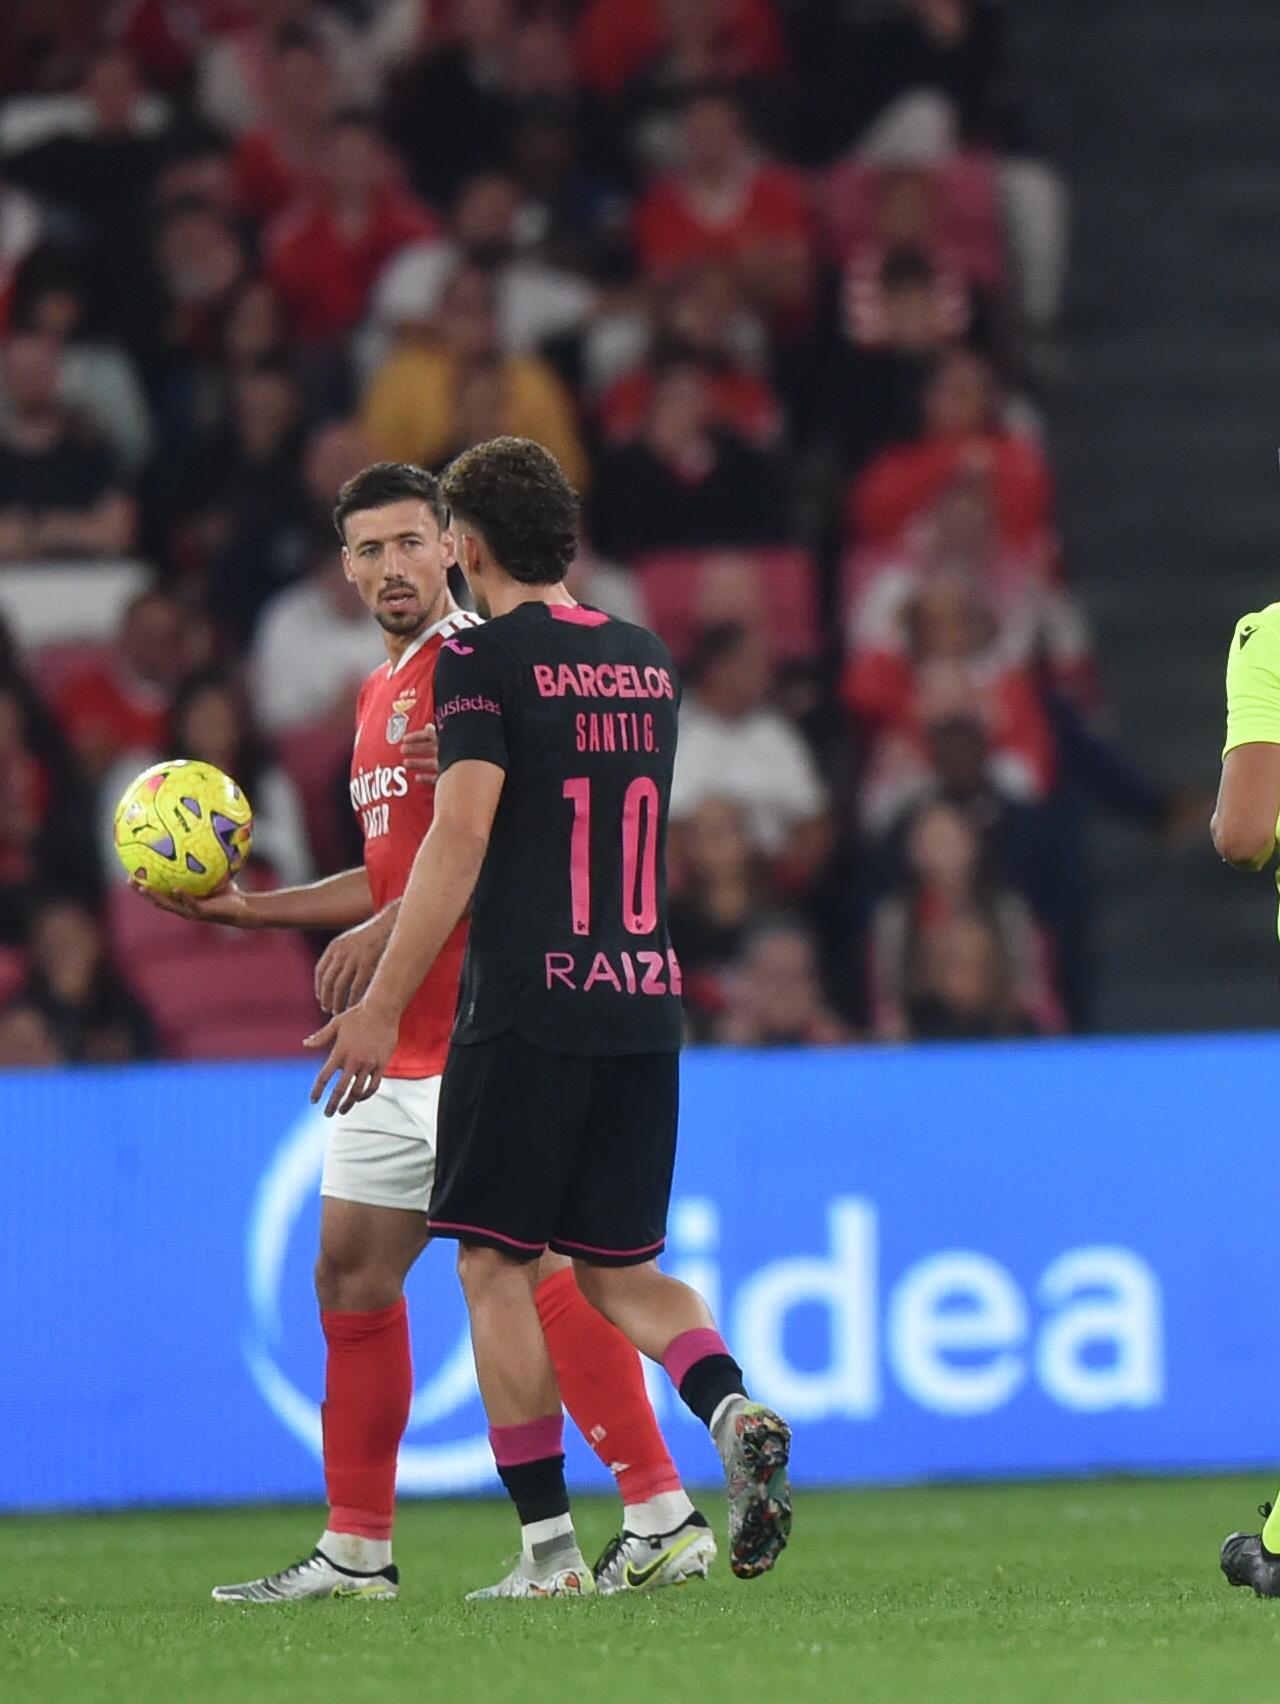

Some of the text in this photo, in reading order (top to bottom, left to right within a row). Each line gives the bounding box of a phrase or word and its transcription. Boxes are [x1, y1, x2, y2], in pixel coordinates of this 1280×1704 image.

[533, 663, 674, 700] BARCELOS
[563, 776, 658, 935] 10
[655, 1194, 1164, 1420] idea
